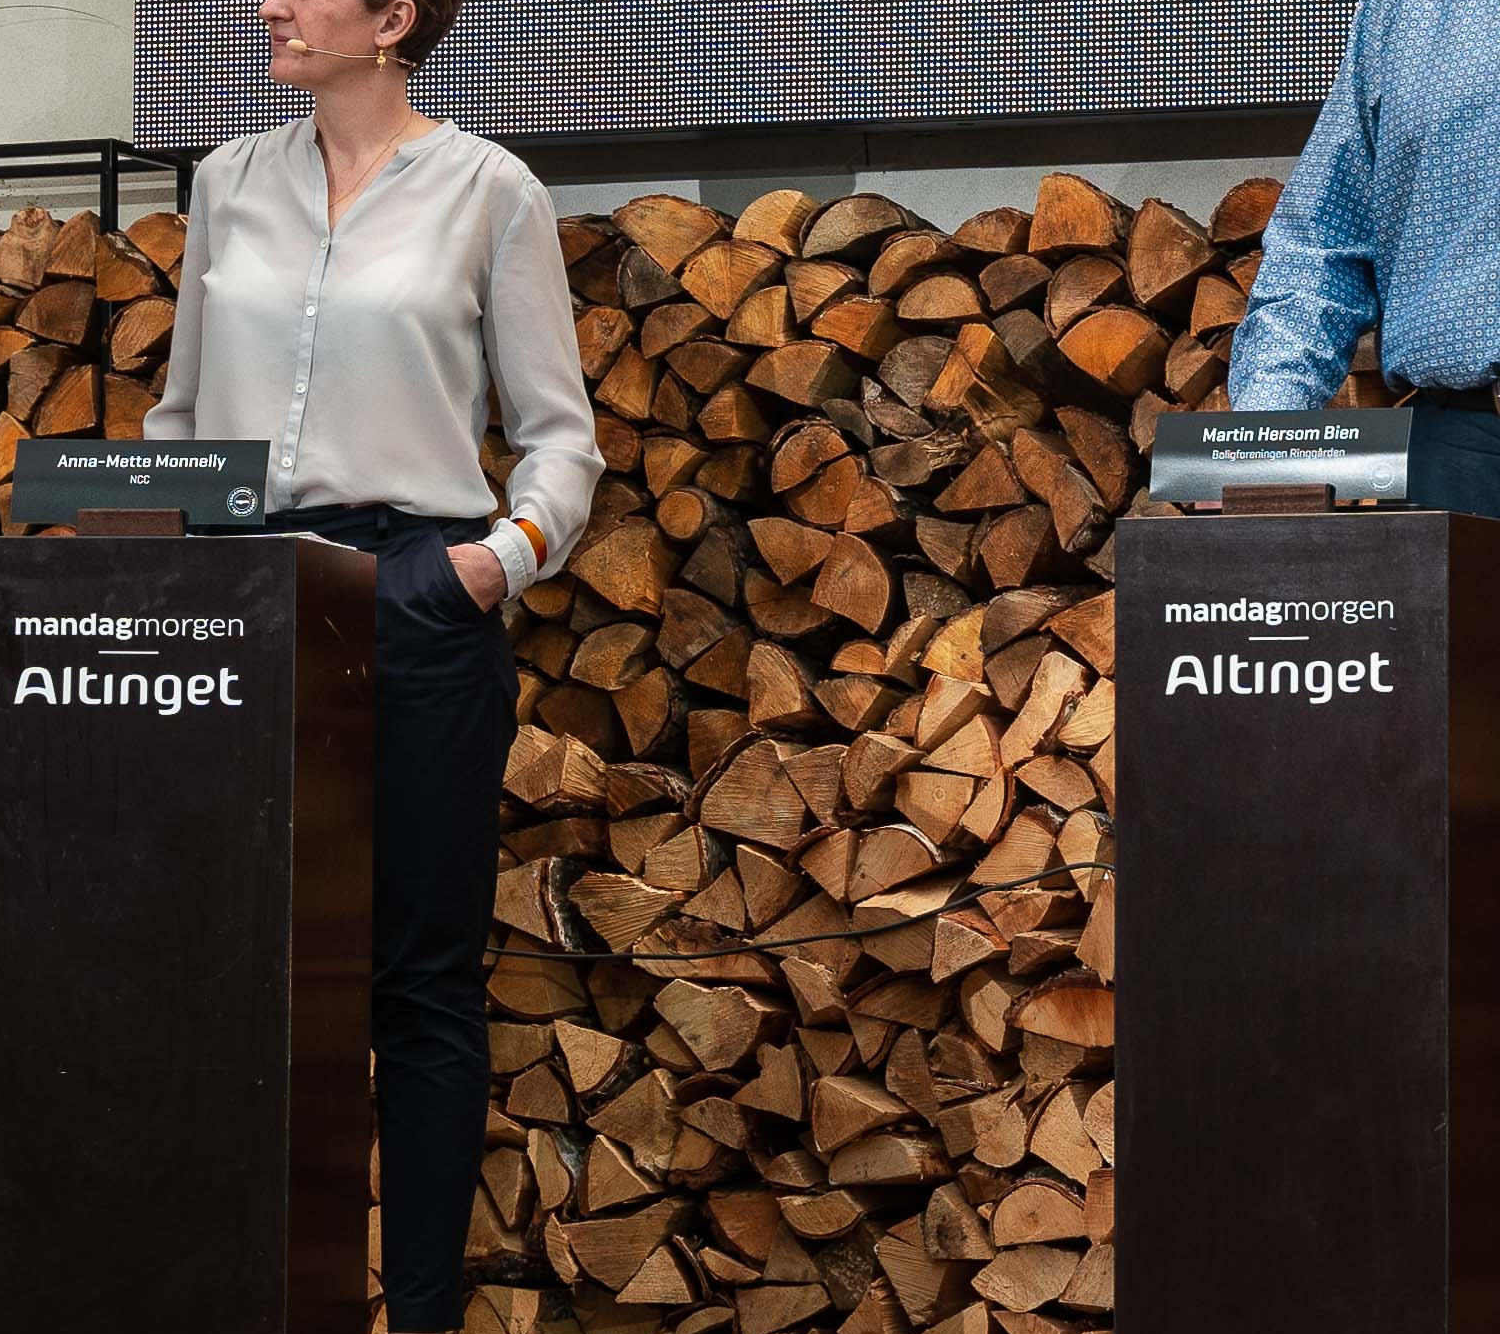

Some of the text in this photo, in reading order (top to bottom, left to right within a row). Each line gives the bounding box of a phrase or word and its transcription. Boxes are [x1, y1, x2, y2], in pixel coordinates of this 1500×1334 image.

[1202, 424, 1360, 444] Martin Hersom Bien
[57, 453, 228, 472] Anna-Mette Monnelly
[1211, 446, 1346, 463] Boligforeningen Ringgården
[129, 474, 151, 485] NCC
[1165, 597, 1395, 626] mandagmorgen
[14, 612, 245, 641] mandagmorgen
[1165, 651, 1394, 705] Altinget
[13, 665, 243, 716] Altinget
